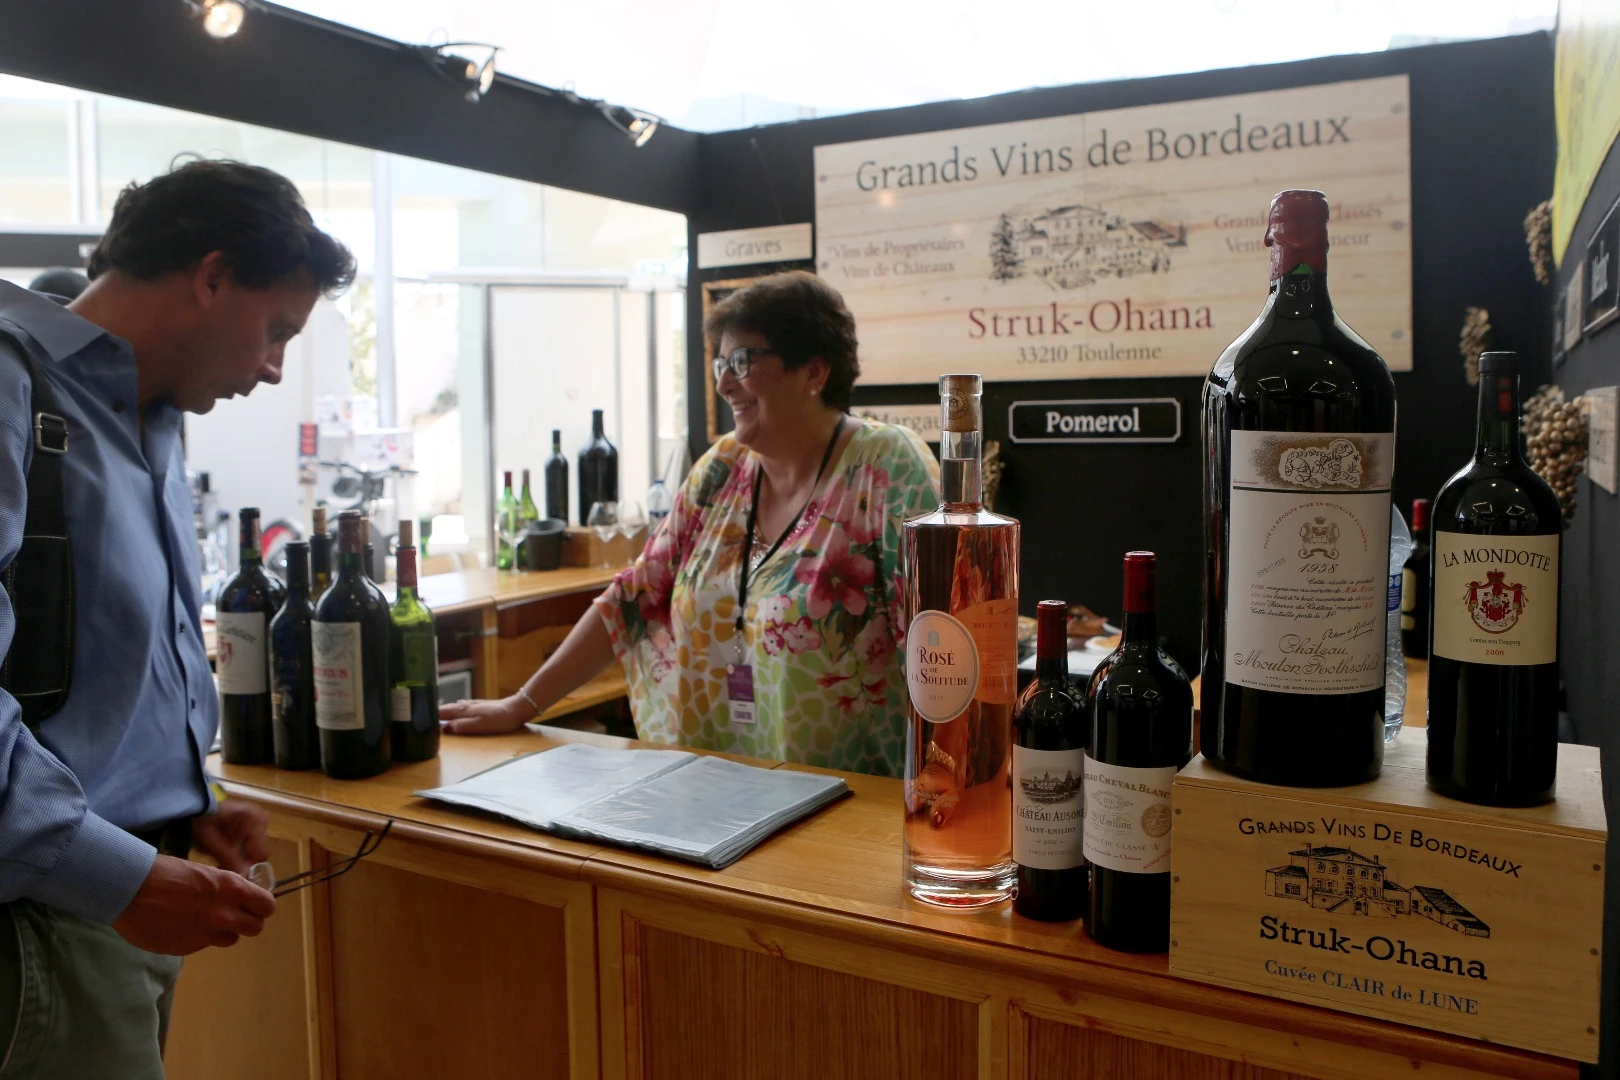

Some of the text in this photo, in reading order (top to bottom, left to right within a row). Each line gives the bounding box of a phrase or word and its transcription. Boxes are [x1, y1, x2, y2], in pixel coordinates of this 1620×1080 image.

[856, 113, 1351, 192] Grands Vins de Bordeaux
[1214, 210, 1268, 229] Grand
[725, 240, 783, 257] Graves
[864, 241, 880, 256] de
[873, 262, 890, 277] de
[968, 297, 1214, 339] Struk-Ohana
[1016, 343, 1162, 364] 33210 Toulenne
[873, 413, 941, 435] Margau
[1046, 407, 1140, 432] Pomerol
[1256, 556, 1288, 578] SPECIMEN
[1299, 562, 1340, 574] 1958
[1443, 548, 1552, 572] LA MONDOTTE
[1278, 634, 1350, 655] Château
[1485, 649, 1505, 657] 2006
[917, 646, 955, 666] ROSÉ
[1233, 650, 1379, 675] Mouton Rothschild
[920, 668, 969, 686] SOLITUDE
[1098, 774, 1137, 791] CHEVAL
[1138, 784, 1171, 800] BLANC
[1016, 805, 1051, 821] CHÂTEAU
[1025, 825, 1078, 835] SAINT-EMILION
[1238, 817, 1524, 879] GRANDS VINS DE BORDEAUX
[1259, 915, 1488, 981] Struk-Ohana
[1265, 959, 1479, 1015] Cuvée CLAIR de LUNE
